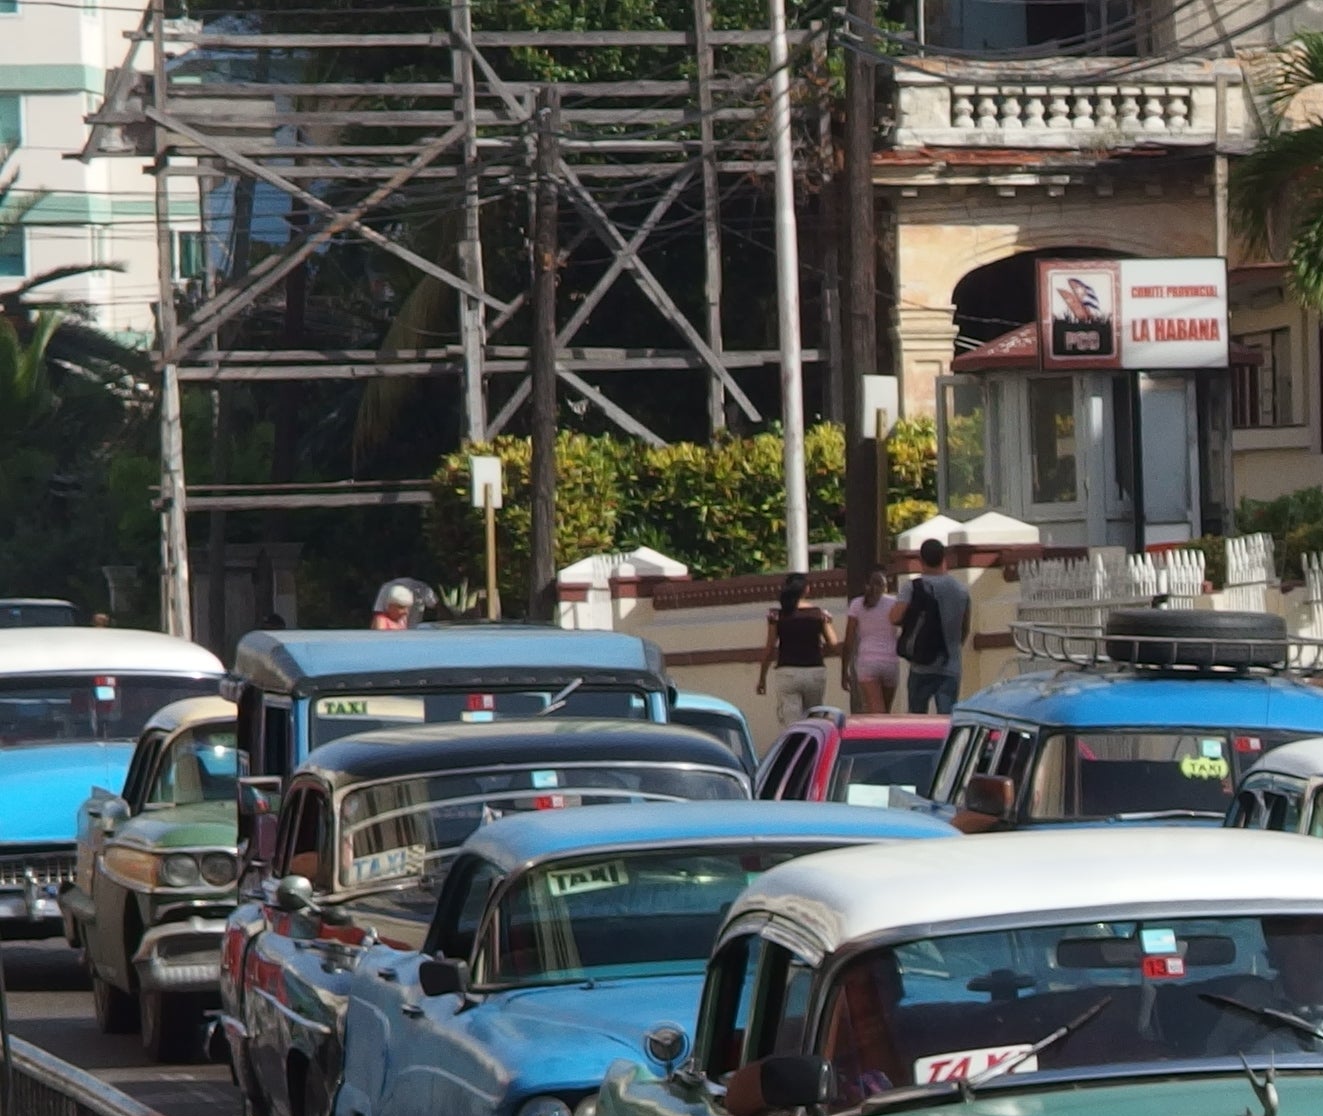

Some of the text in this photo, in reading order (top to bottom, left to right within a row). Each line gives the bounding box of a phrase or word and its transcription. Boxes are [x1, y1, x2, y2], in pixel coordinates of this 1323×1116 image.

[1132, 318, 1220, 342] LA HABANA
[324, 701, 368, 716] TAXI
[1190, 762, 1222, 773] TAXI
[353, 850, 408, 881] TAXI
[551, 862, 620, 892] TAXI
